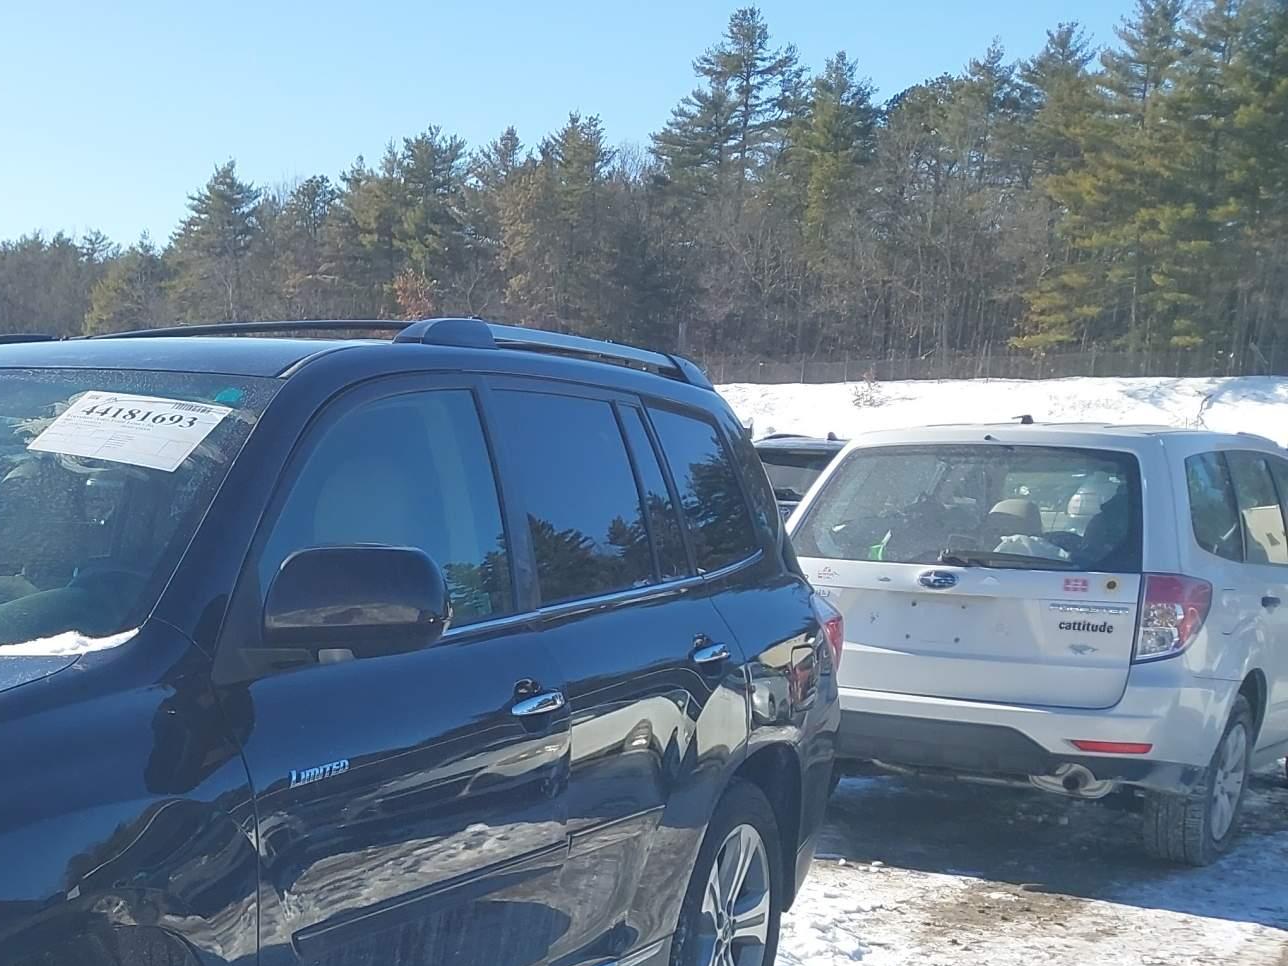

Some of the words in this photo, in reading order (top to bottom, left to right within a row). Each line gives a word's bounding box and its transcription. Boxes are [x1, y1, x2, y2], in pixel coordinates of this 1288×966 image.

[82, 404, 199, 429] 44181693
[1059, 621, 1114, 633] cattitude
[289, 759, 350, 788] LIMITED
